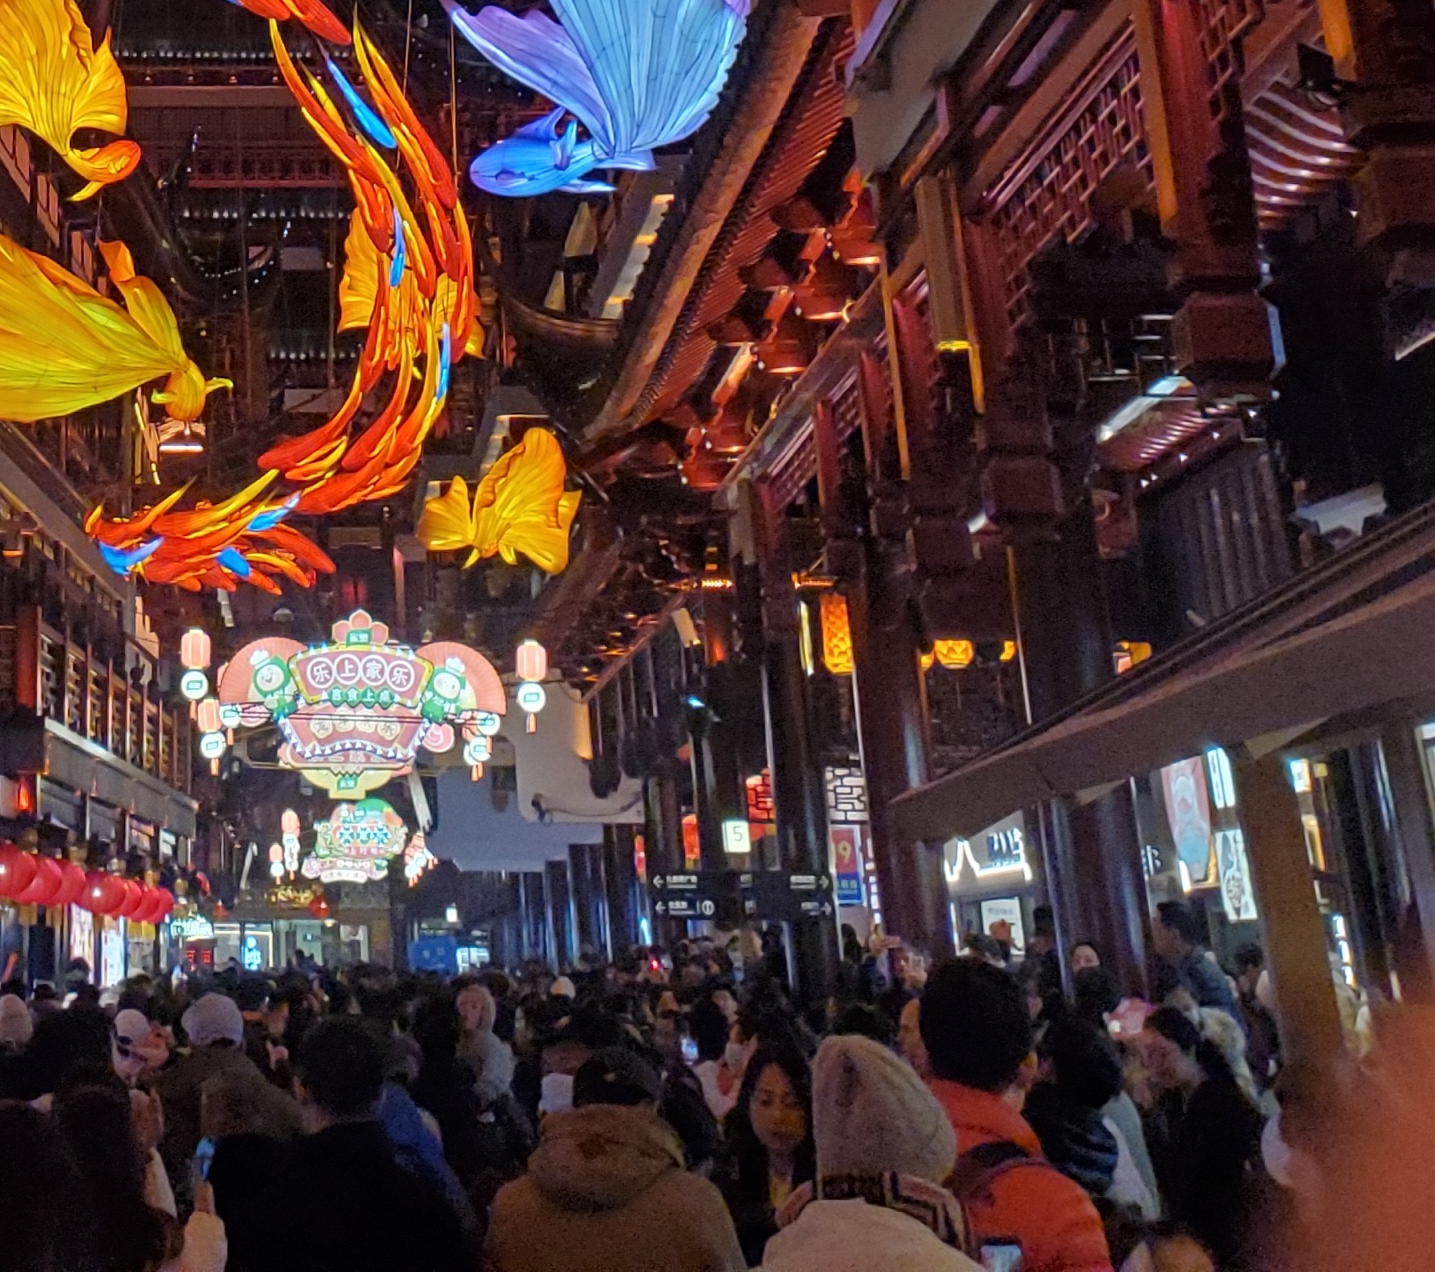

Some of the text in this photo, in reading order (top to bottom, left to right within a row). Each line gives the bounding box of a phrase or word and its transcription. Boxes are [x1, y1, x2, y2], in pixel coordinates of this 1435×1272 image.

[314, 659, 410, 686] 乐上家乐
[733, 825, 743, 842] 5
